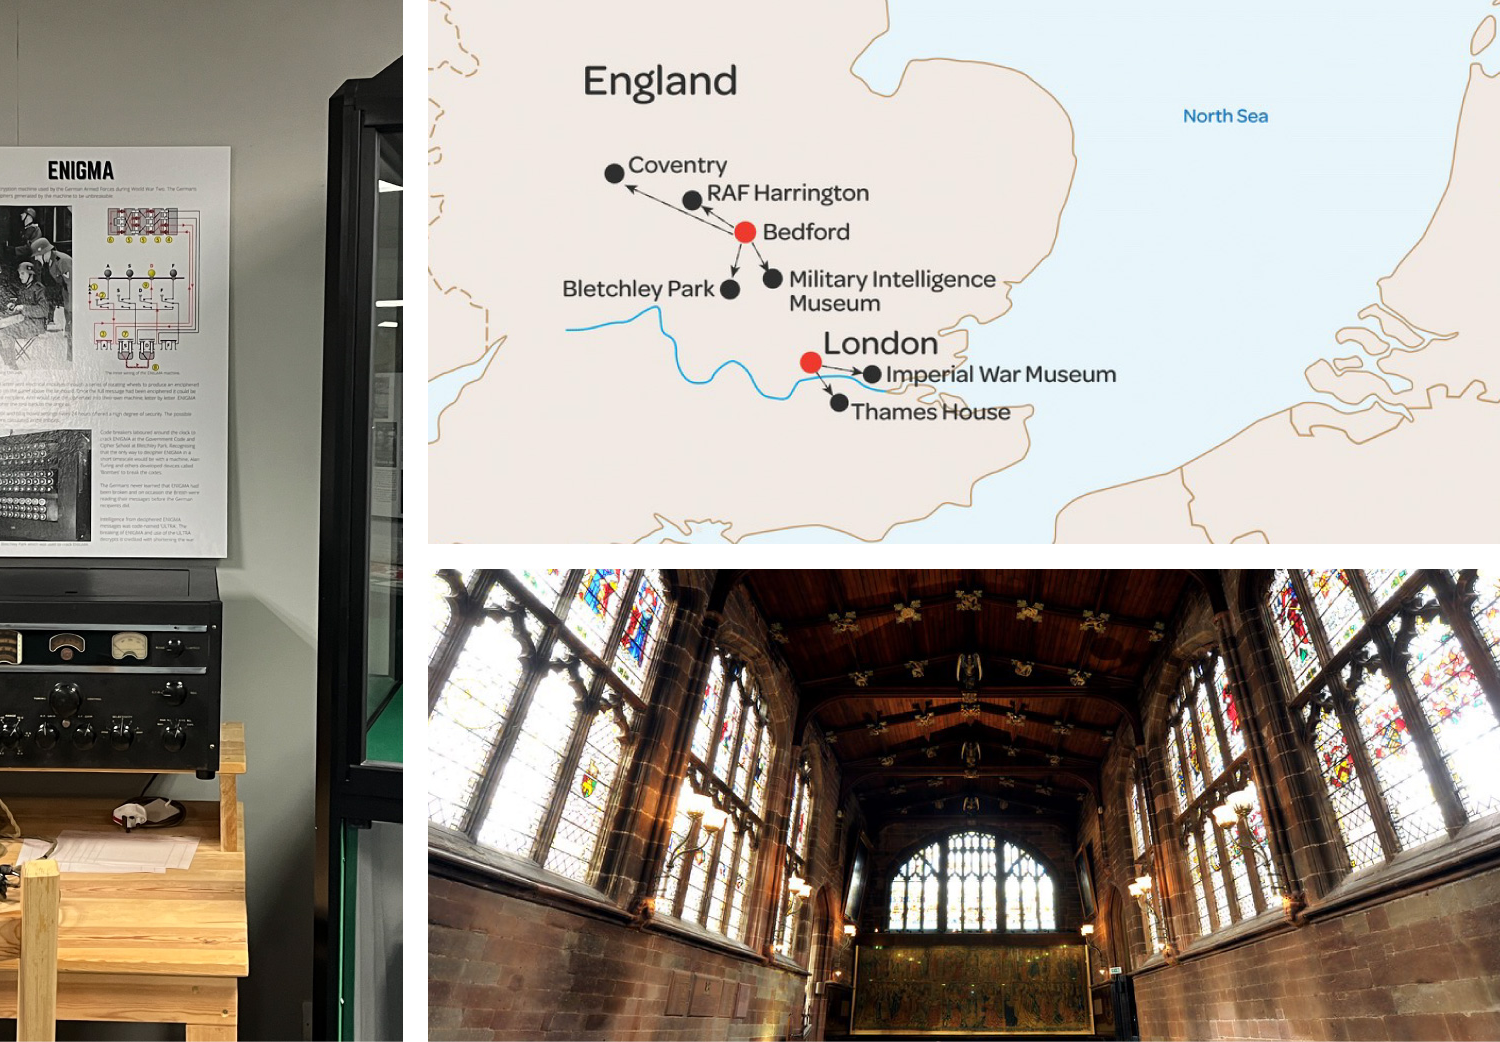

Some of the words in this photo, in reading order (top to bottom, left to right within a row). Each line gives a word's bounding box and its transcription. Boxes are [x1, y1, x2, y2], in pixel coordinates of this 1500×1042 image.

[585, 65, 736, 104] England
[1184, 109, 1232, 122] North
[1238, 109, 1268, 123] Sea
[48, 160, 114, 180] ENIGMA
[629, 157, 727, 177] Coventry
[709, 185, 749, 201] RAF
[755, 184, 868, 205] Harrington
[764, 223, 849, 240] Bedford
[564, 280, 662, 301] Bletchley
[669, 280, 714, 296] Park
[791, 270, 867, 291] Military
[874, 270, 995, 292] Intelligence
[791, 295, 879, 311] Museum
[825, 331, 937, 354] London
[888, 365, 972, 386] Imperial
[980, 366, 1021, 382] War
[1027, 366, 1116, 382] Museum
[852, 403, 937, 420] Thames
[943, 404, 1010, 420] House
